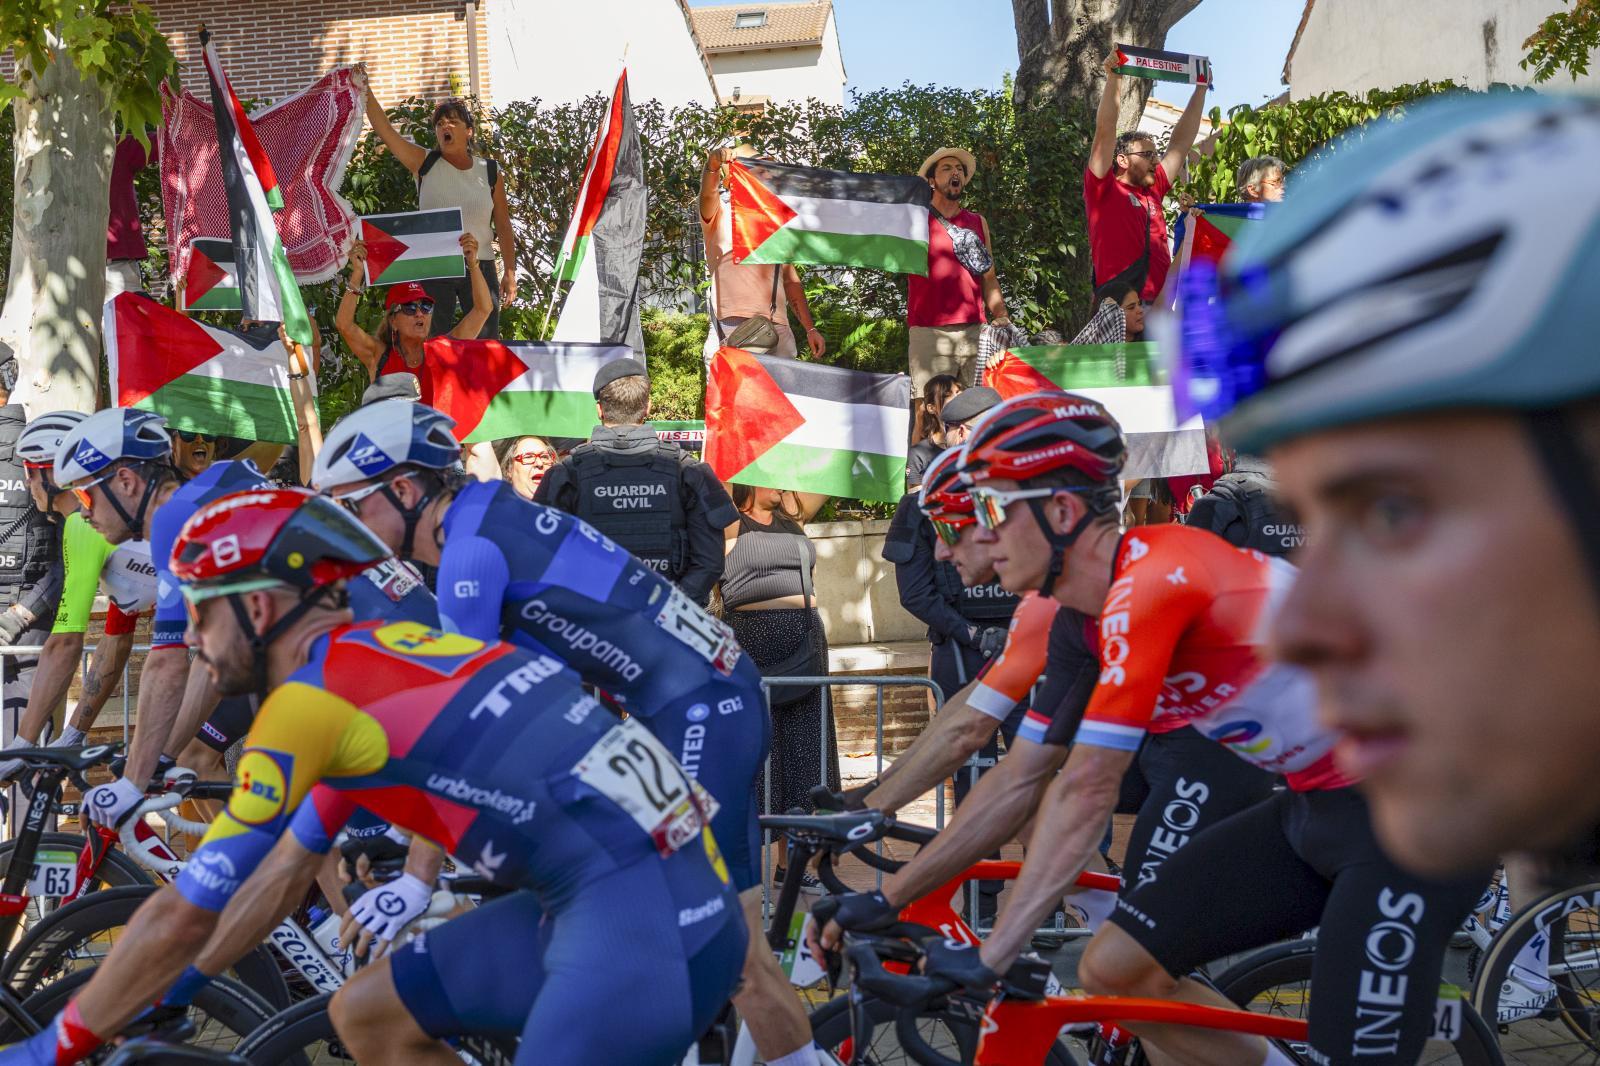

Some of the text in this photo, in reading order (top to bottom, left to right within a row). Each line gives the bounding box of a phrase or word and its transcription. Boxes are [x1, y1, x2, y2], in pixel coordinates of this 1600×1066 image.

[1136, 57, 1183, 72] PALESTINE
[594, 484, 668, 497] GUARDIA
[612, 497, 652, 509] CIVIL
[520, 598, 644, 682] Groupama
[1100, 575, 1135, 687] INEOS
[608, 738, 682, 812] 22
[27, 791, 49, 832] INEOS
[44, 867, 71, 895] 63
[271, 923, 335, 993] ilier
[1352, 886, 1426, 1058] INEOS
